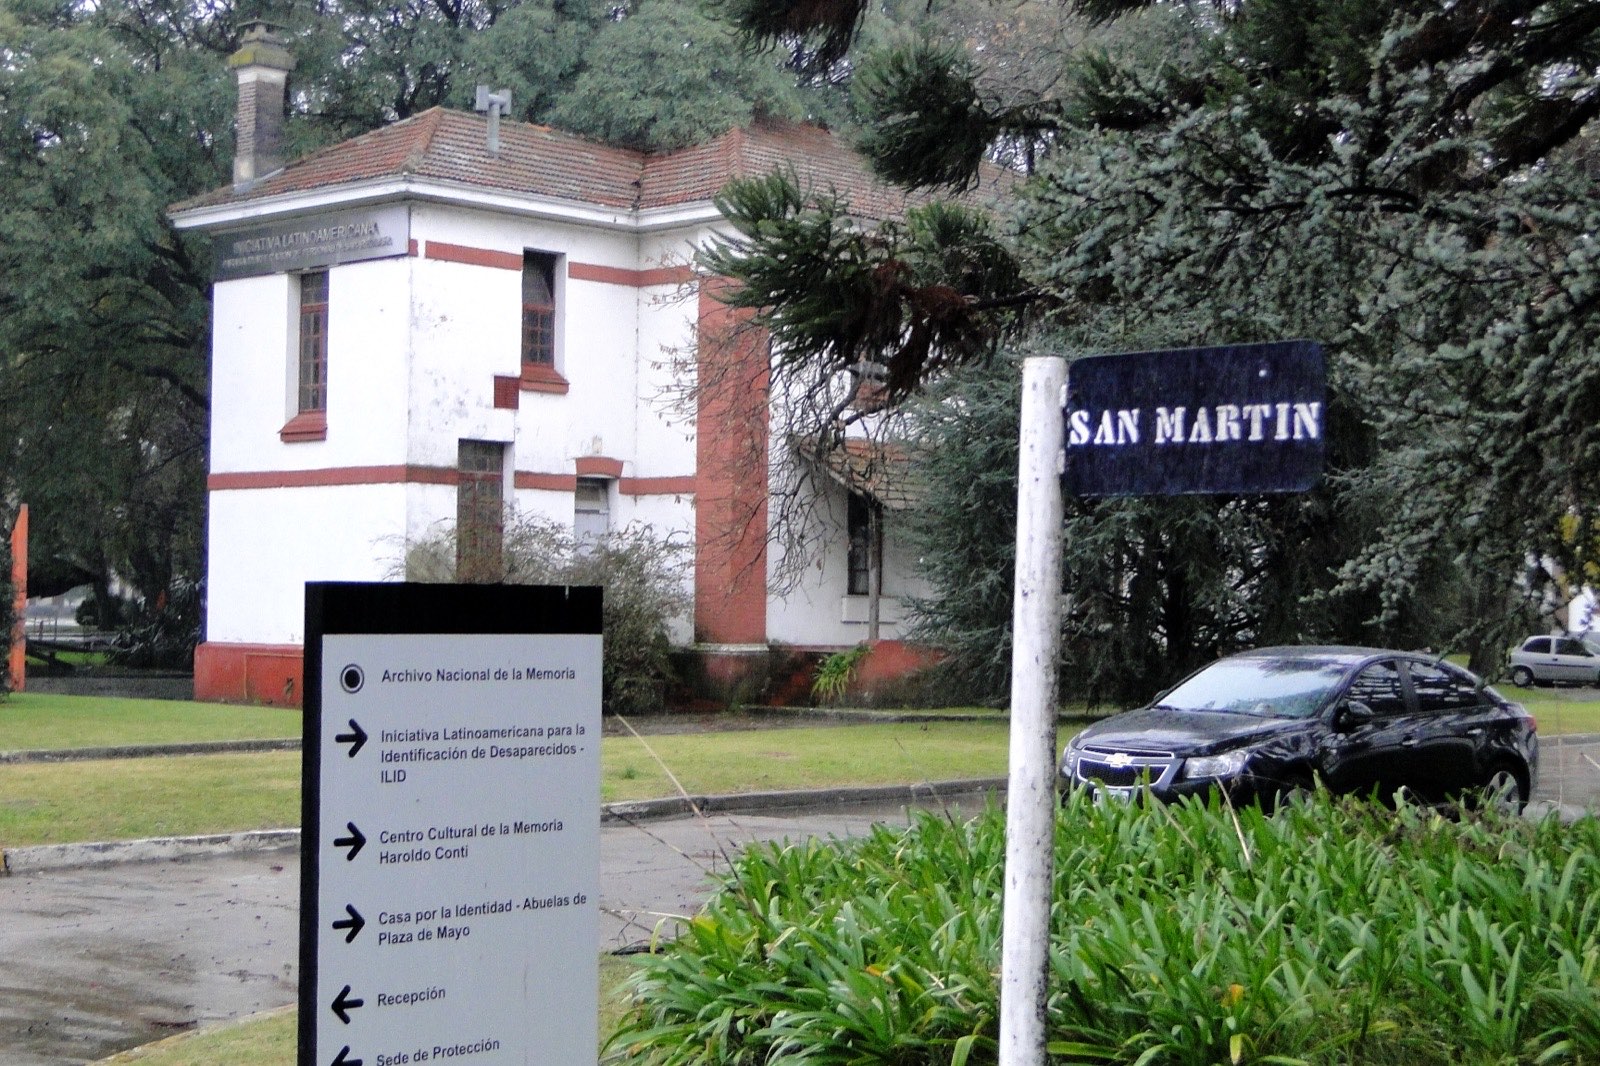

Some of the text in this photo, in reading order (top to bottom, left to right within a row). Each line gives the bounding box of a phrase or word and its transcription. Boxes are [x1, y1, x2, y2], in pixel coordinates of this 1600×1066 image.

[233, 236, 281, 254] CIATIVA
[1069, 402, 1321, 445] SAN MARTIN
[381, 667, 576, 683] Archivo Nacional de la Memoria
[381, 723, 586, 743] Iniciativa Latinoamericana para la
[381, 746, 467, 763] Identificación
[471, 746, 486, 760] de
[490, 743, 577, 760] Desaparecidos
[381, 769, 407, 783] ILID
[380, 818, 563, 844] Centro Cultural de la Memoria
[380, 845, 469, 864] Haroldo Conti
[379, 911, 411, 926] Casa
[415, 909, 438, 925] por
[441, 905, 452, 919] la
[455, 899, 513, 917] Identidad
[523, 894, 570, 911] Abuelas
[573, 892, 587, 906] de
[378, 925, 470, 946] Plaza de Mayo
[377, 986, 446, 1007] Recepción
[376, 1037, 500, 1066] Sede de Protección
